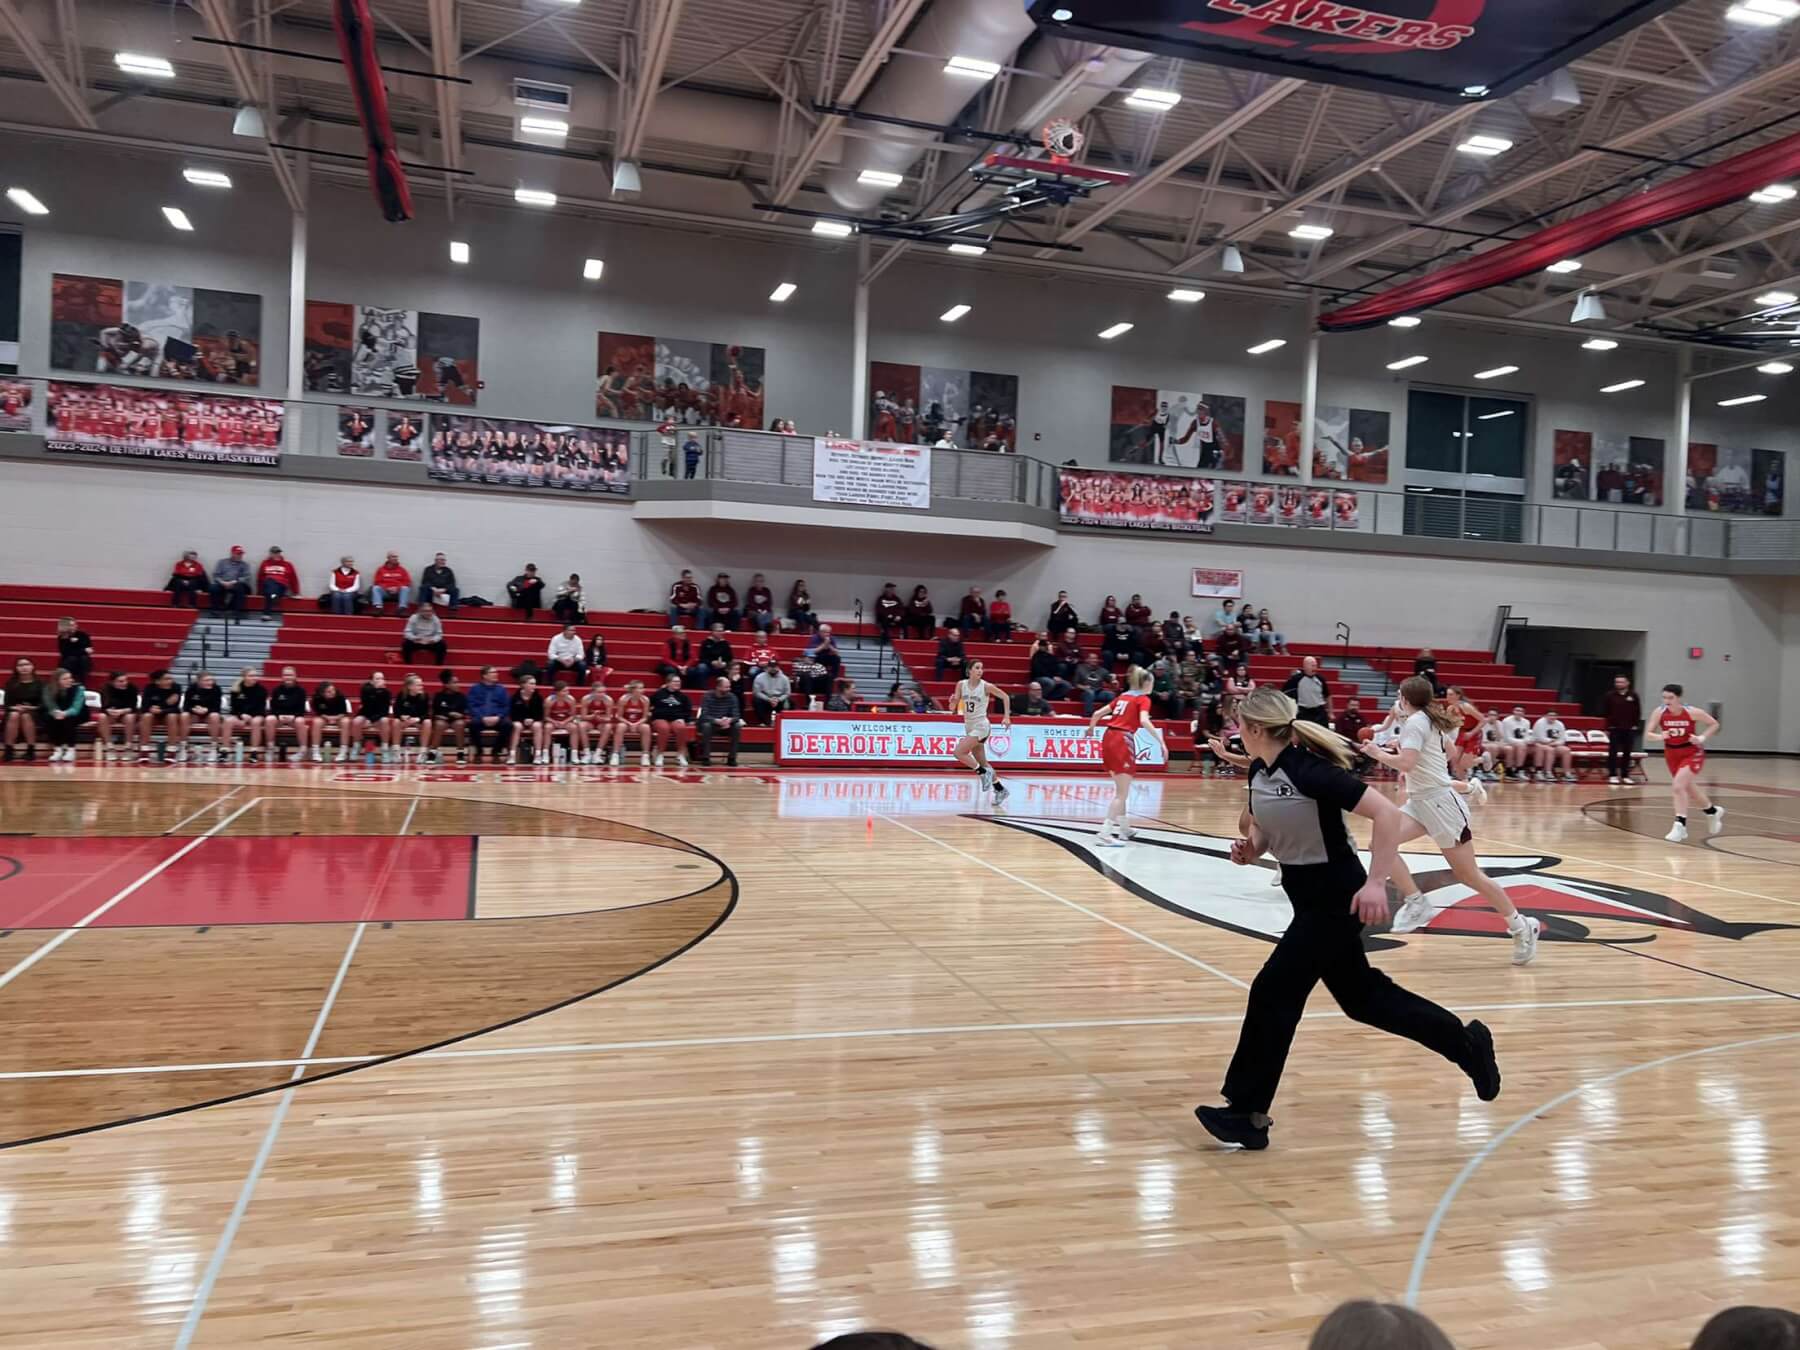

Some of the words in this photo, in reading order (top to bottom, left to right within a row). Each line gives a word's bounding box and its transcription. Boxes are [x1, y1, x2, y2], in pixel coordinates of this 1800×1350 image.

[47, 440, 107, 452] 2023-2024
[110, 445, 151, 456] DETROIT
[154, 449, 185, 459] LAKES
[187, 452, 215, 461] BOYS
[216, 453, 277, 465] BASKETBALL
[966, 701, 975, 713] 13
[1113, 700, 1128, 715] 21
[851, 724, 897, 733] WELCOME
[901, 725, 912, 733] TO
[1044, 728, 1064, 737] HOME
[1070, 729, 1080, 737] OF
[788, 733, 891, 756] DETROIT
[896, 735, 962, 757] LAKE
[1027, 737, 1104, 760] LAKER
